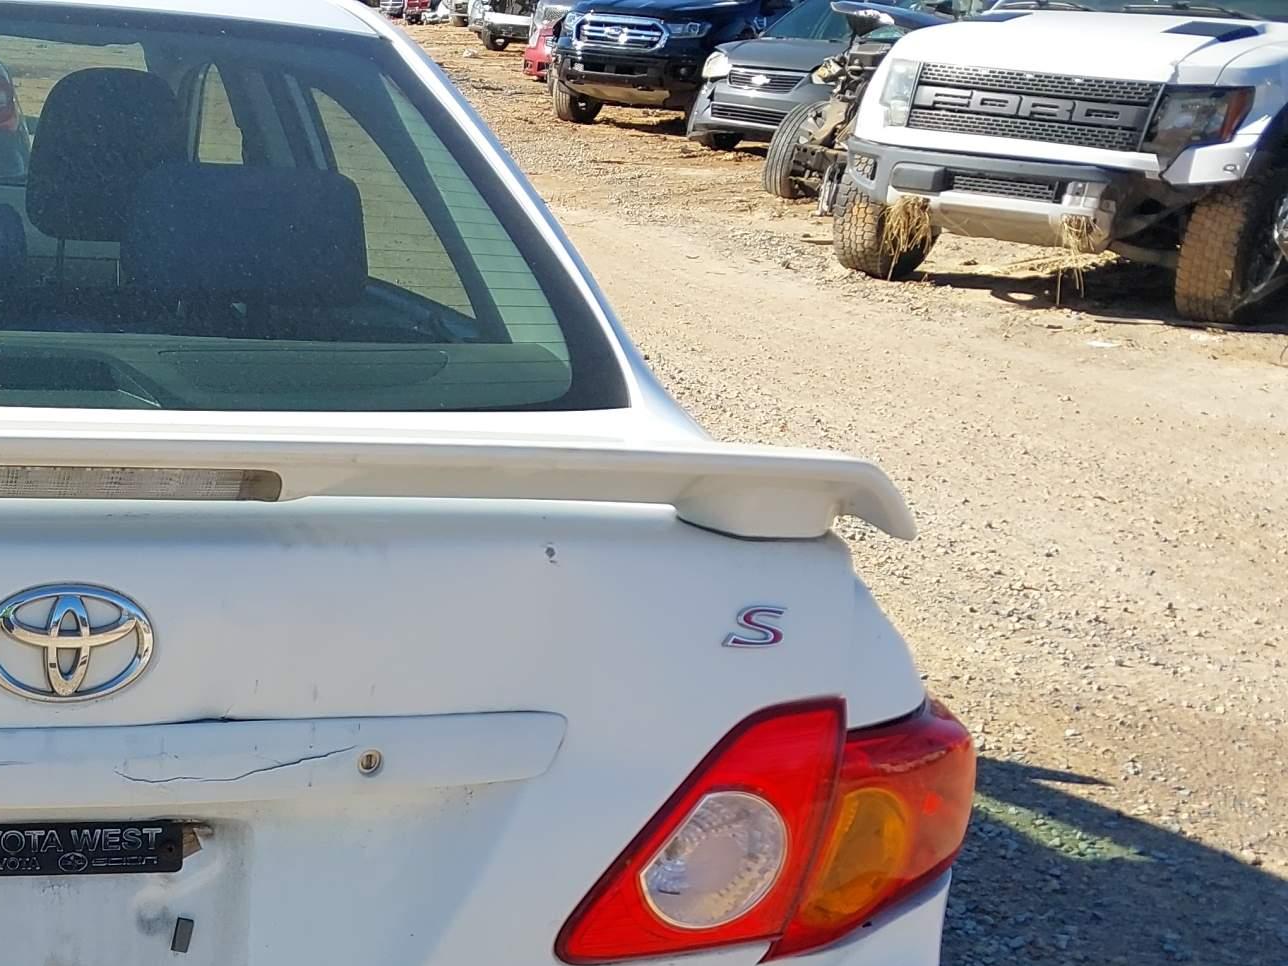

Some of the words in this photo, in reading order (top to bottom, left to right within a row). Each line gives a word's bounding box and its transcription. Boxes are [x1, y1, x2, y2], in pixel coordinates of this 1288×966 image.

[919, 86, 1130, 128] FORD
[722, 606, 787, 647] S
[70, 828, 162, 852] WEST
[92, 856, 158, 867] SCION
